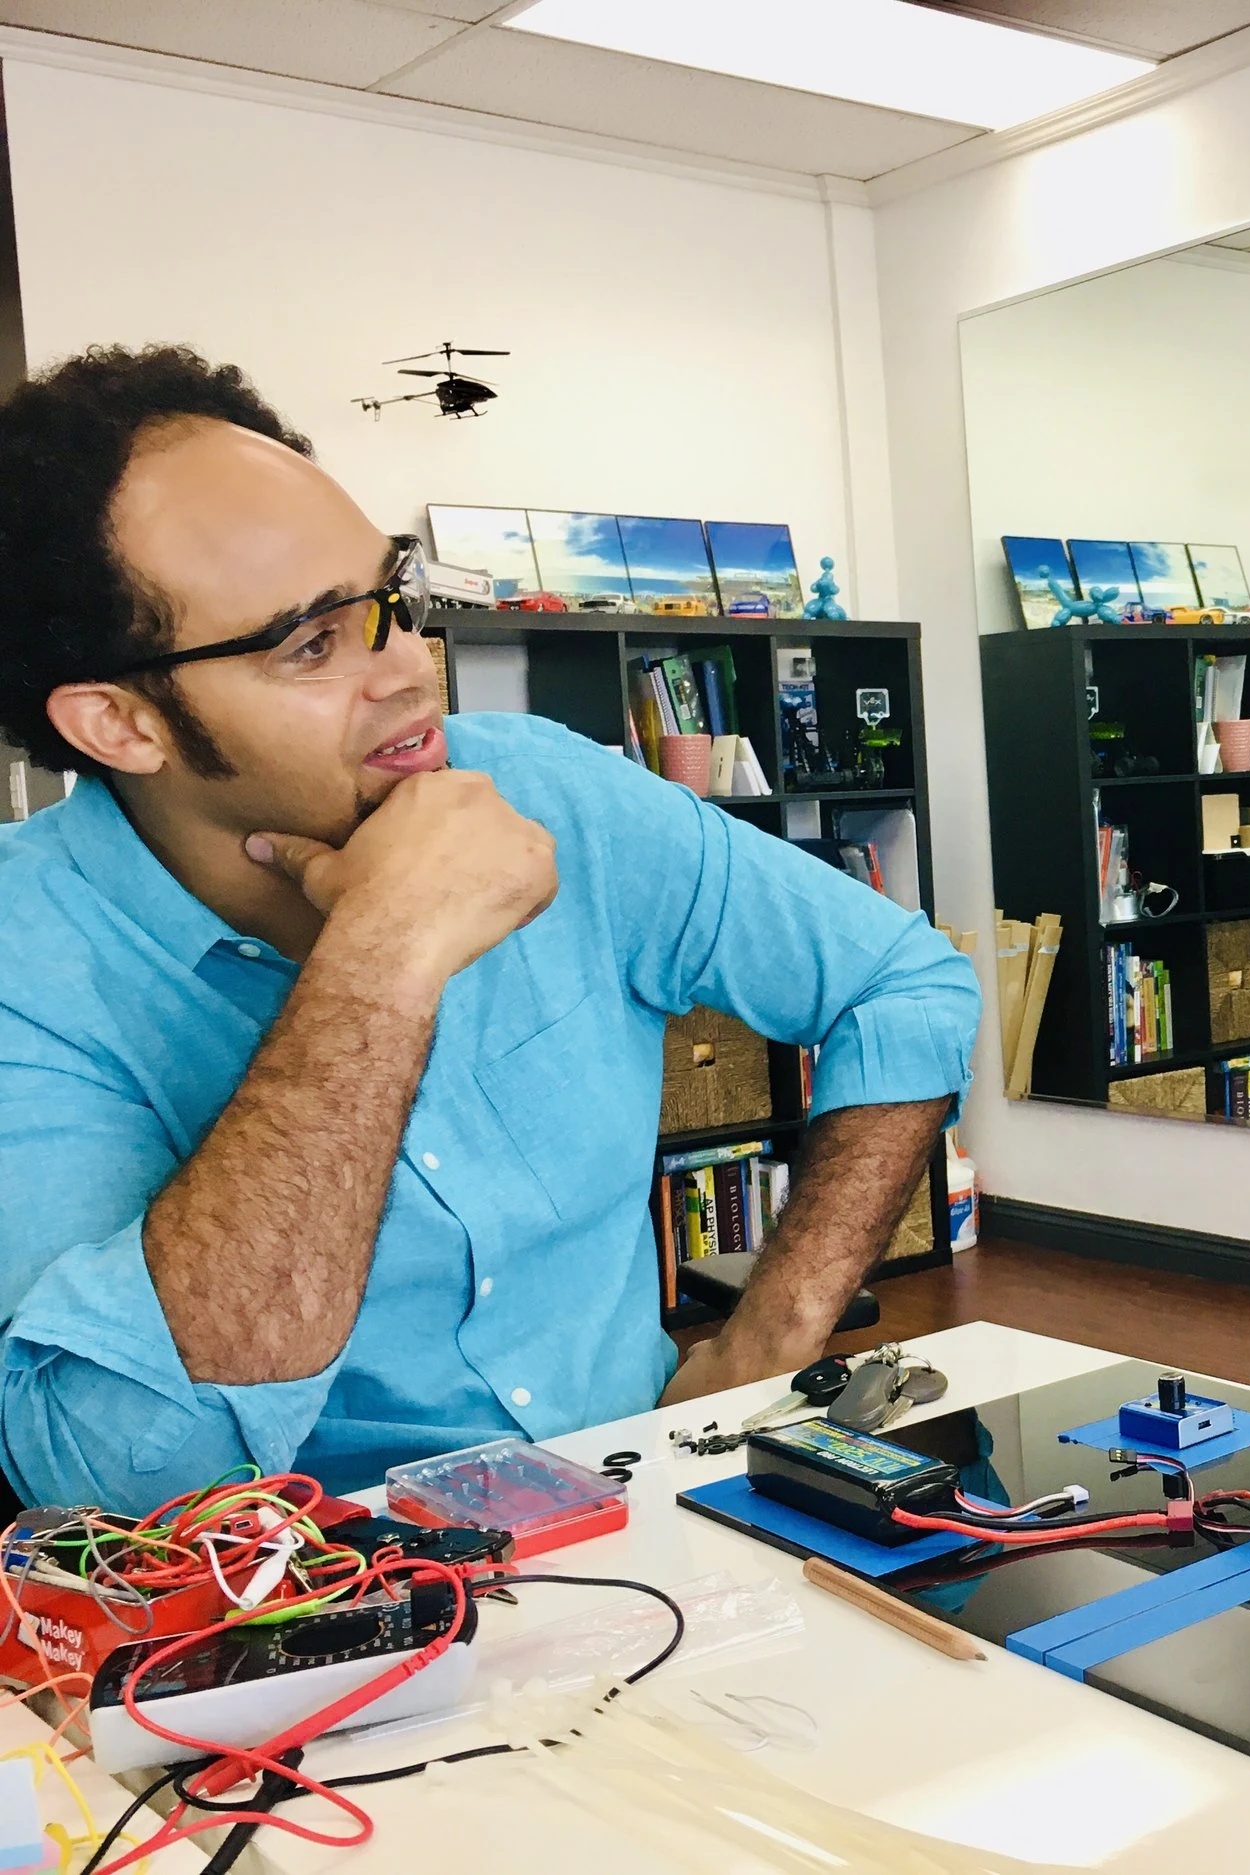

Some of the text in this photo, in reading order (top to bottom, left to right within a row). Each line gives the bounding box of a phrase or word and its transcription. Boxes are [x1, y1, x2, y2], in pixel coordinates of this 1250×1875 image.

[705, 1198, 714, 1217] AP
[730, 1185, 741, 1251] BIOLOGY
[41, 1616, 82, 1648] Makey
[41, 1639, 83, 1671] Makey
